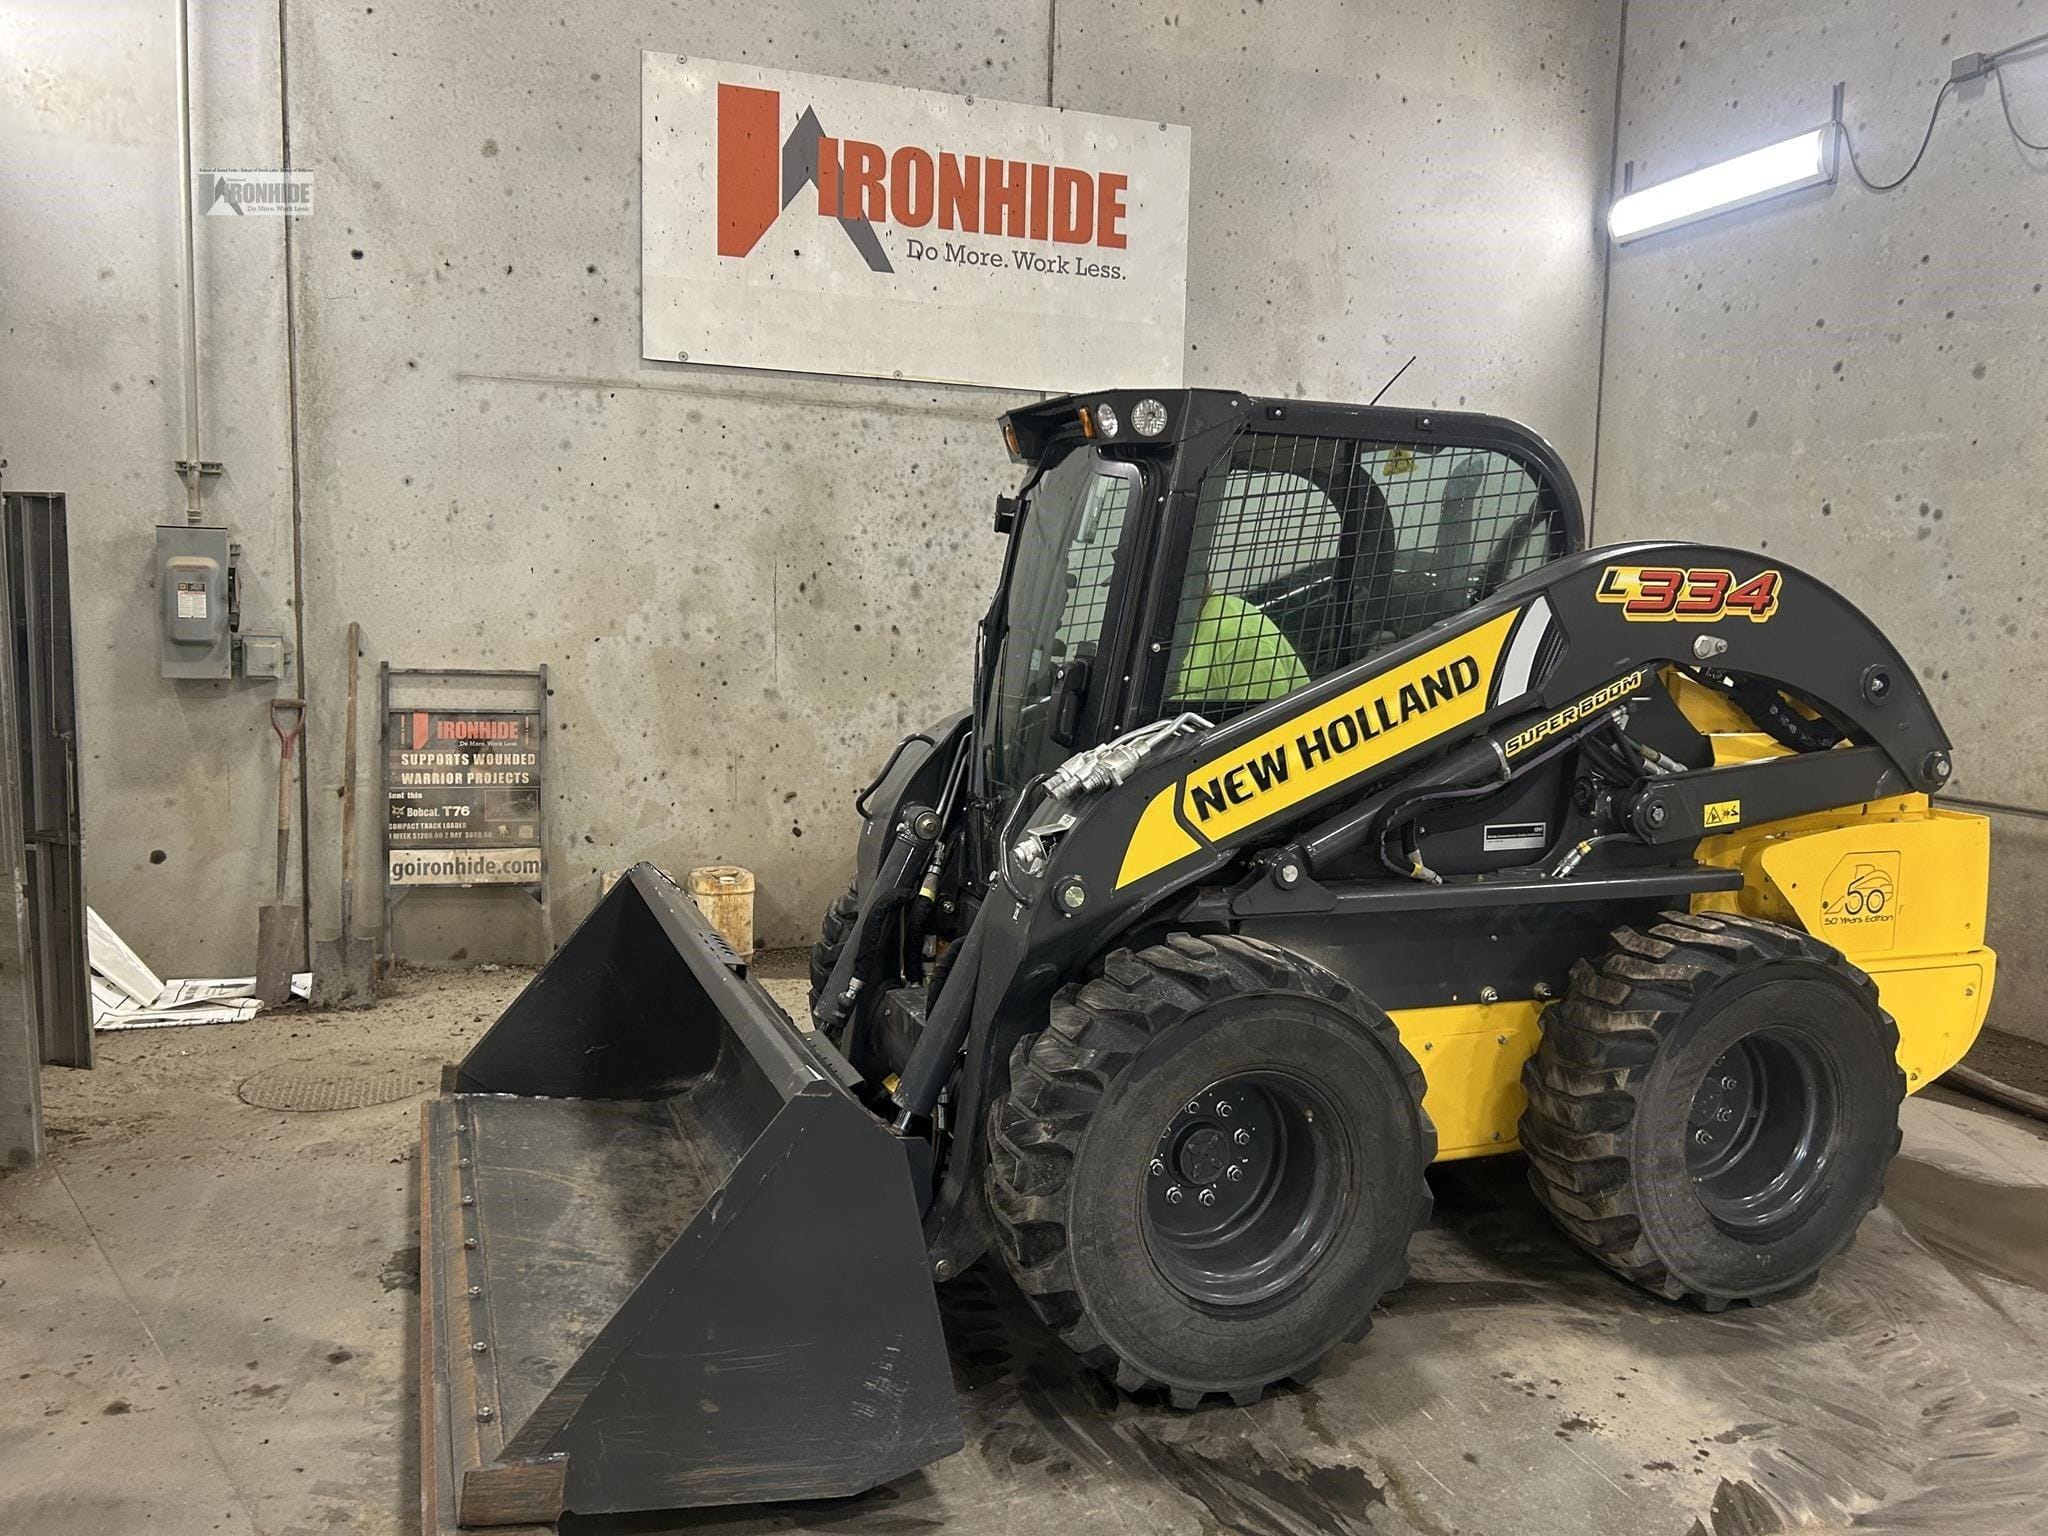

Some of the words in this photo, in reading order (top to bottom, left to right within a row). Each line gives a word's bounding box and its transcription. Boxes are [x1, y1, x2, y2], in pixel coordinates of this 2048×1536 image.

[818, 136, 1128, 249] IRONHIDE
[906, 239, 938, 261] Do
[945, 244, 1009, 268] More.
[1012, 250, 1070, 274] Work
[1075, 257, 1127, 281] Less.
[1596, 567, 1781, 620] L334
[1505, 706, 1579, 758] SUPER
[1579, 671, 1642, 717] BOOM
[437, 720, 519, 740] IRONHIDE
[1190, 744, 1290, 823] NEW
[1295, 655, 1481, 772] HOLLAND
[401, 753, 470, 766] SUPPORTS
[473, 753, 536, 766] WOUNDED
[401, 772, 463, 785] WARRIOR
[467, 772, 530, 784] PROJECTS
[407, 791, 423, 799] this
[442, 805, 471, 817] T76
[420, 822, 441, 830] TRACK
[391, 856, 540, 881] goironhide.com
[1823, 917, 1838, 926] 50
[1840, 916, 1863, 924] Years
[1864, 914, 1894, 923] Edition
